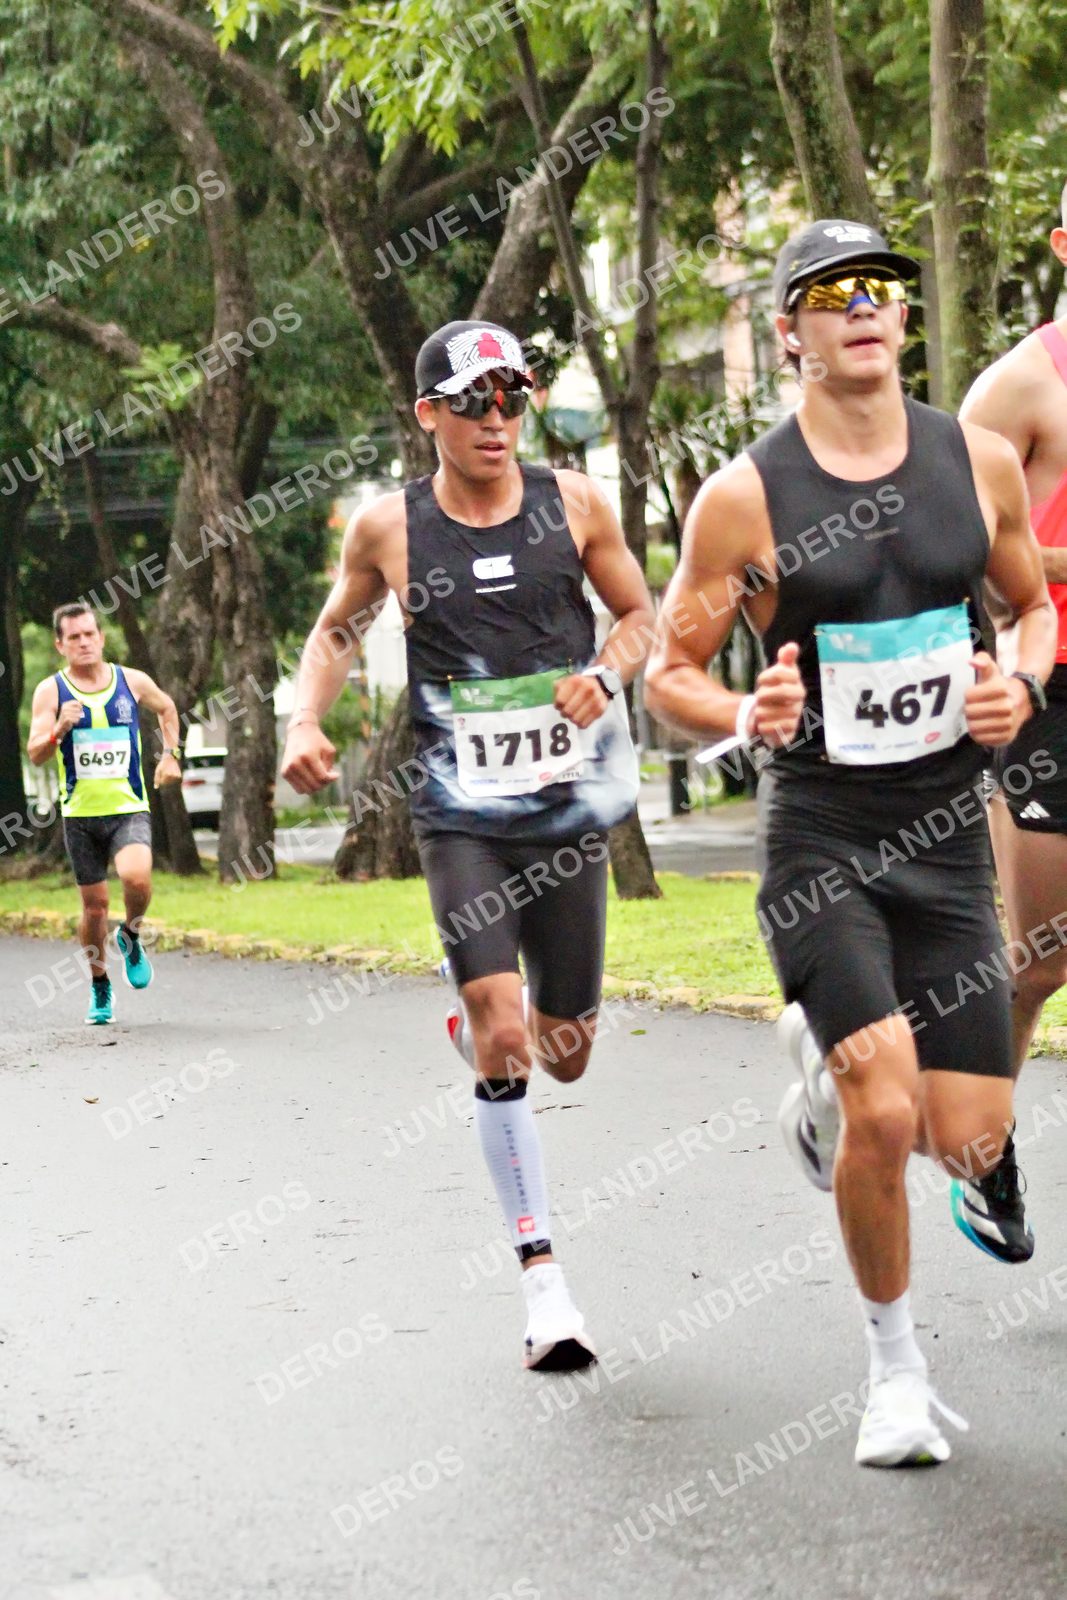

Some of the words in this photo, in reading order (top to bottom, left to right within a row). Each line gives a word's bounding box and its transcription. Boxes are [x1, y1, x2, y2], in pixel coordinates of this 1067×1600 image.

[855, 674, 951, 728] 467
[79, 751, 127, 767] 6497
[469, 722, 571, 767] 1718
